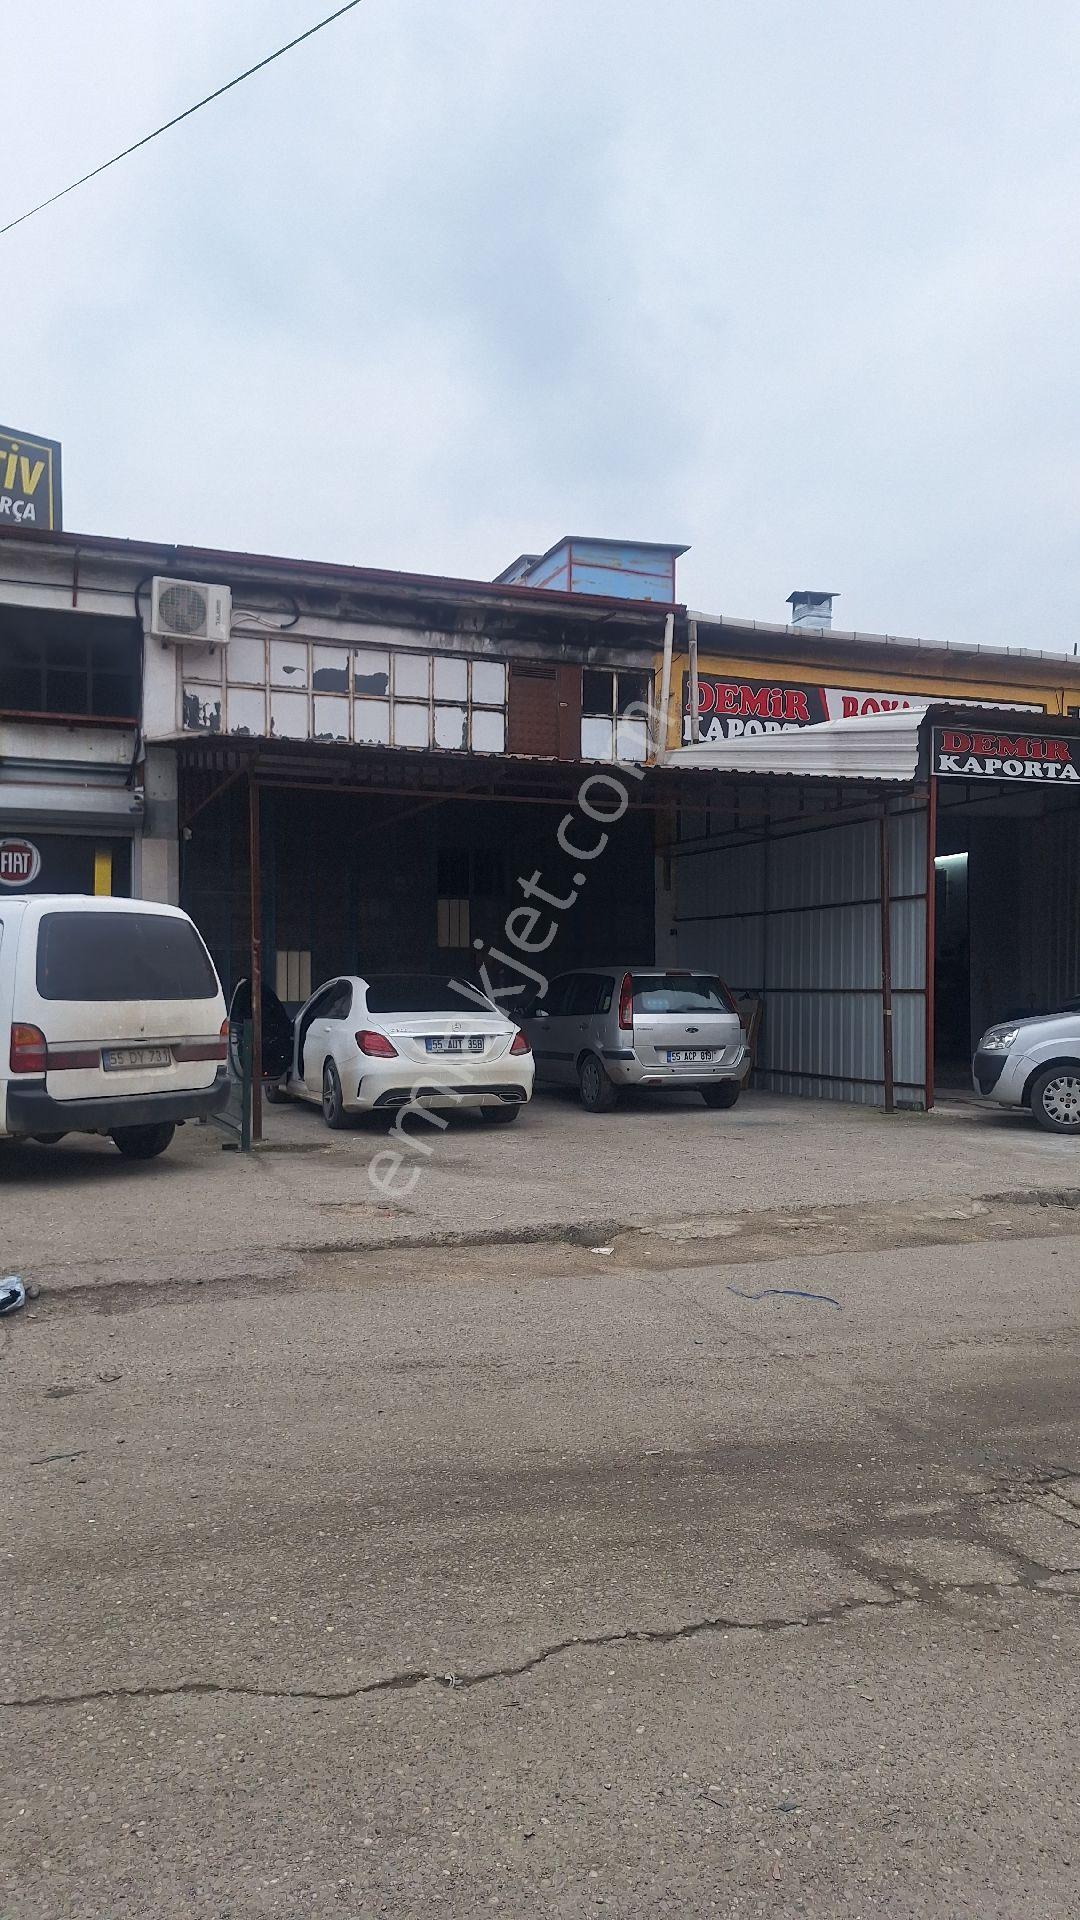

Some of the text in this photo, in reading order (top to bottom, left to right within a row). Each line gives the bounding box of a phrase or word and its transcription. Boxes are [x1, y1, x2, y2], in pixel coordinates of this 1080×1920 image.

[938, 754, 1080, 780] KAPORTA
[1, 851, 30, 873] FIAT
[432, 1039, 443, 1049] 55
[110, 1051, 124, 1065] 55
[671, 1052, 681, 1061] 55
